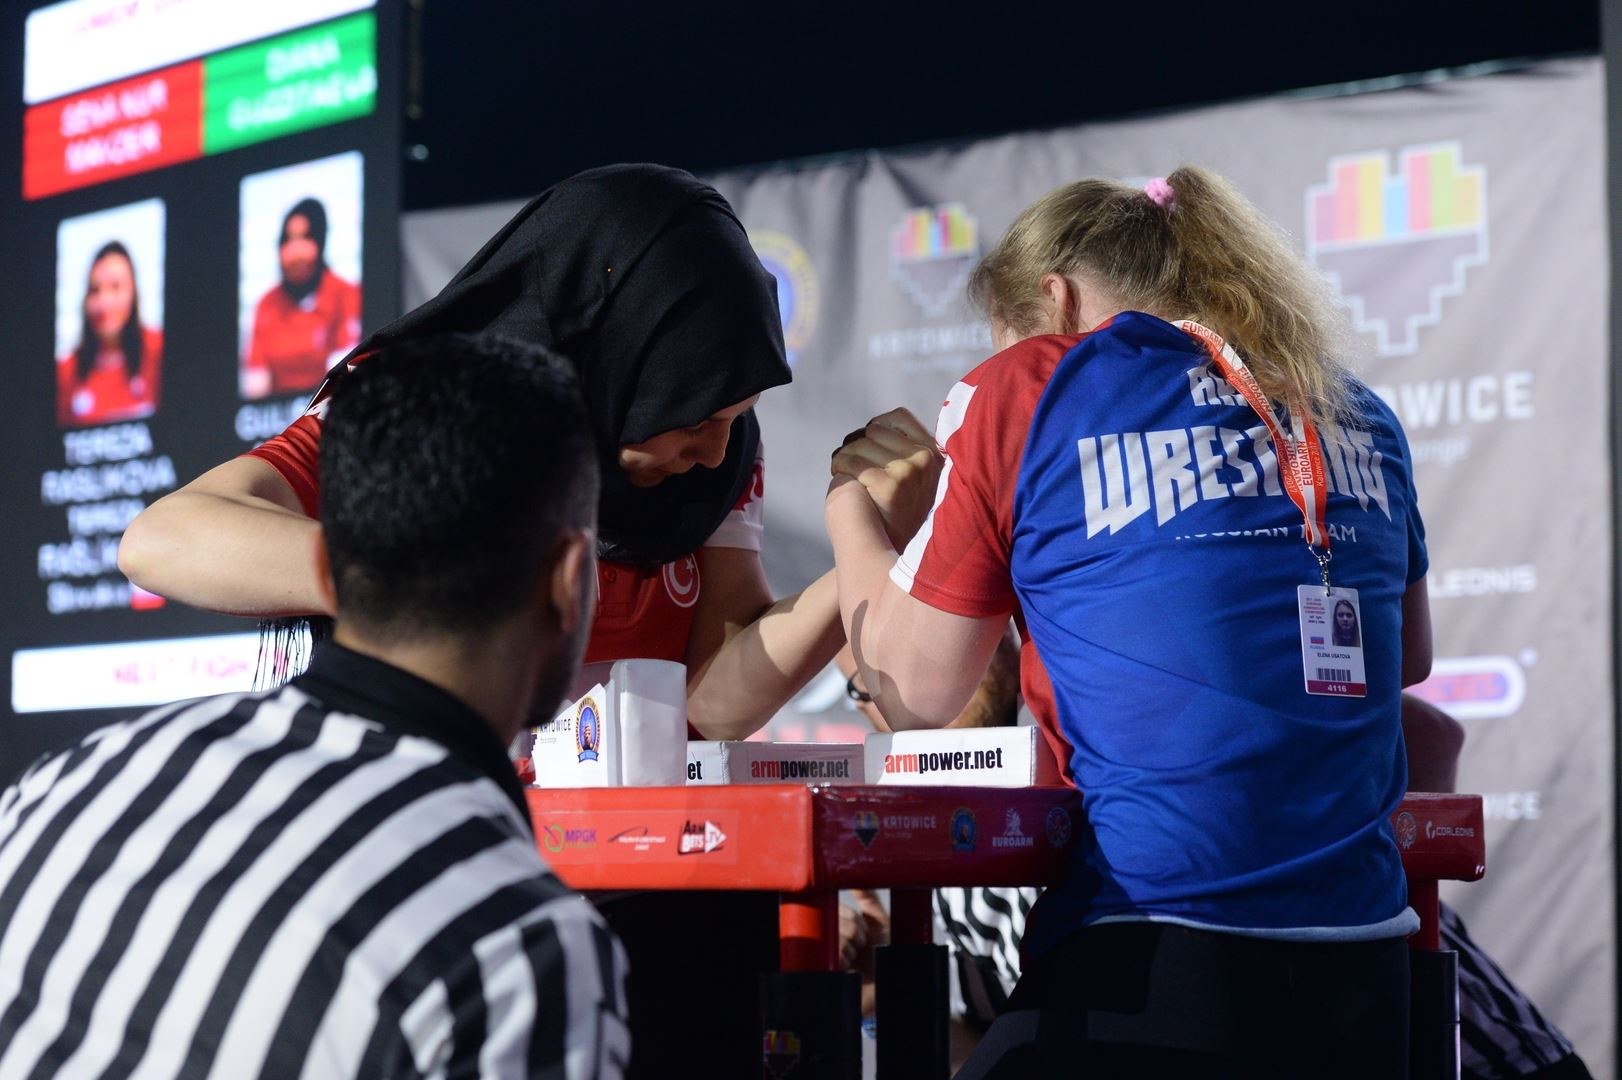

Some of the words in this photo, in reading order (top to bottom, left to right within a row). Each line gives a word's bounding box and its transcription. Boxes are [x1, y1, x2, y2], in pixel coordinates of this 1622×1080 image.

[1374, 370, 1536, 431] WICE
[1296, 440, 1313, 486] EUROARM
[1078, 425, 1392, 540] WRESTING
[1327, 684, 1348, 693] 4116
[751, 759, 849, 780] armpower.net
[885, 748, 1003, 774] armpower.net
[883, 816, 937, 830] KATOWICE
[992, 837, 1034, 847] EUROARM
